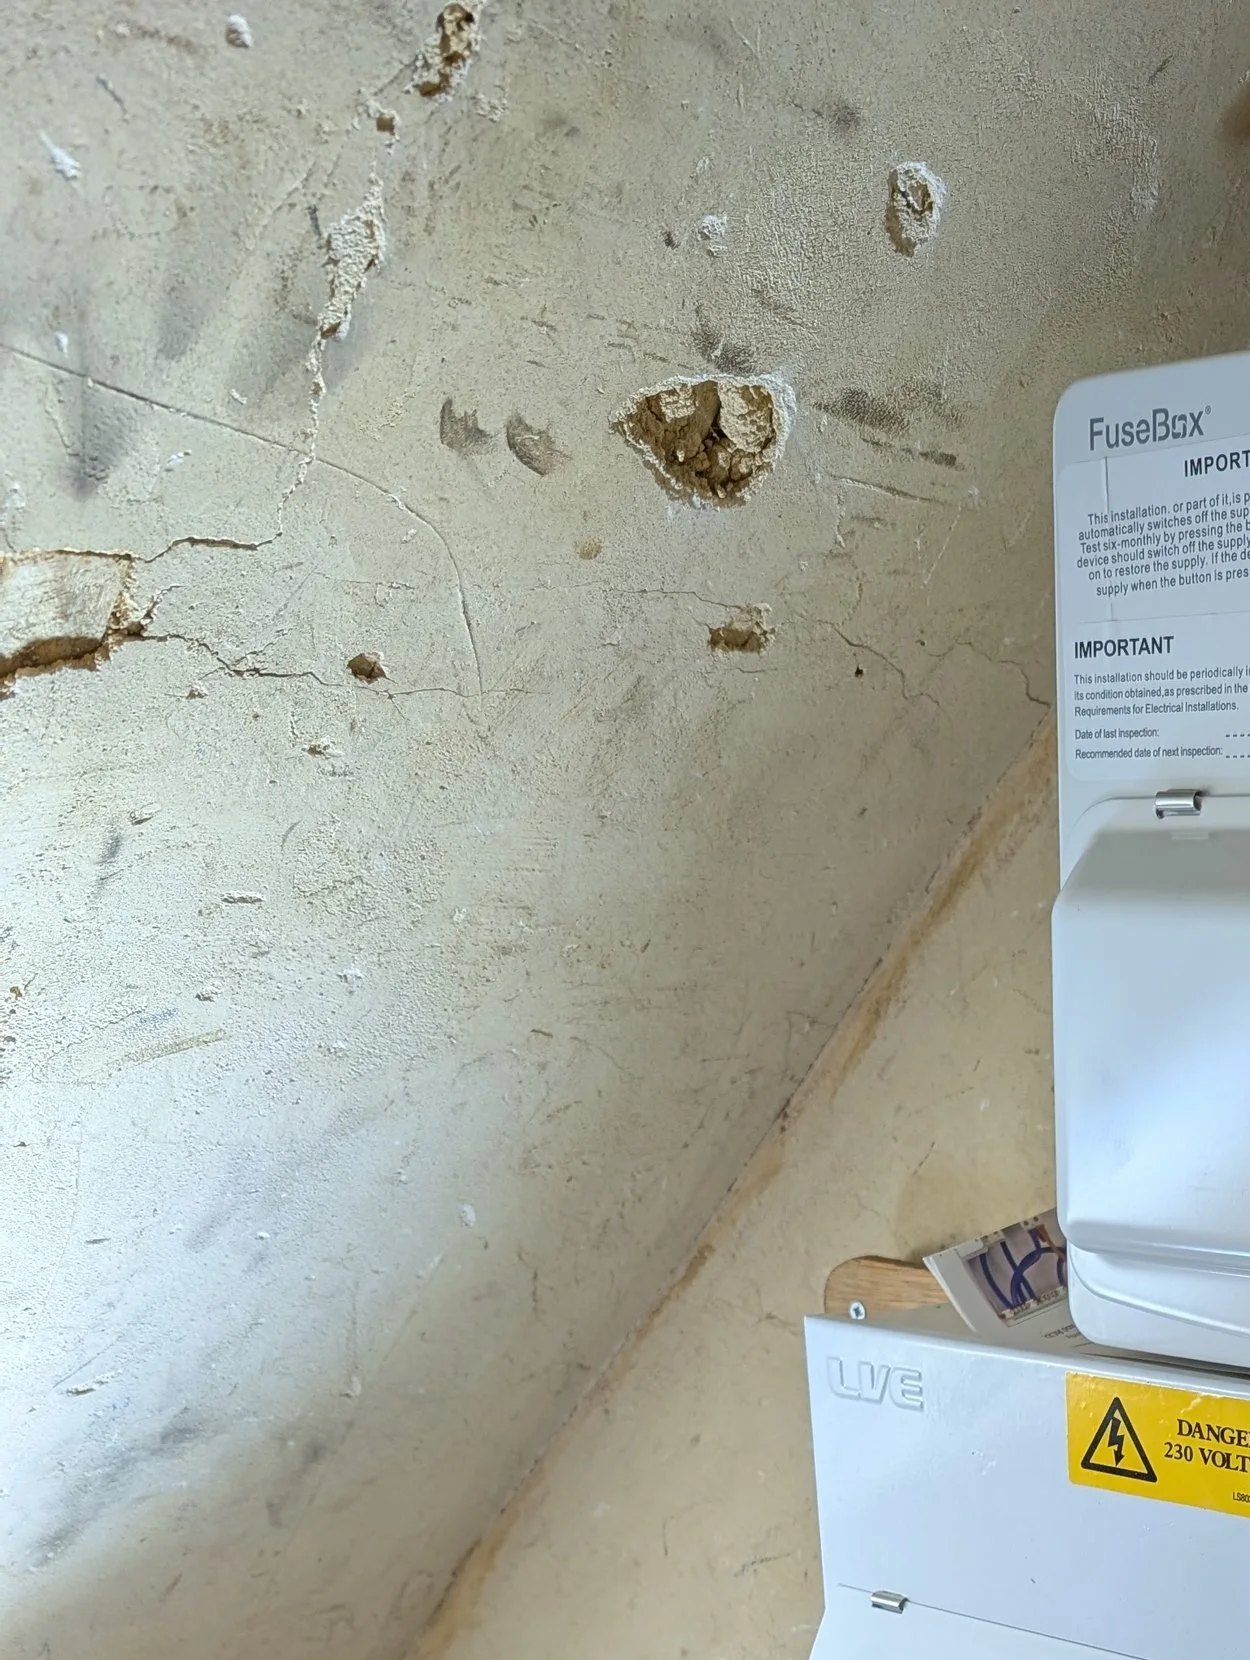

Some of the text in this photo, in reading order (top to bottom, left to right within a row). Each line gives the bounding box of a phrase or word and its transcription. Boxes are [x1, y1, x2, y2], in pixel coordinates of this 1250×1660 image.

[1088, 511, 1108, 525] This
[1172, 502, 1183, 512] or
[1186, 496, 1206, 514] part
[1209, 494, 1219, 507] of
[1078, 520, 1145, 541] automatically
[1146, 514, 1192, 531] switches
[1194, 510, 1208, 524] off
[1210, 508, 1227, 521] the
[1096, 580, 1128, 597] supply
[1130, 577, 1158, 591] when
[1159, 574, 1176, 587] the
[1178, 570, 1212, 585] button
[1213, 568, 1223, 581] is
[1074, 636, 1174, 659] IMPORTANT
[1074, 673, 1092, 685] This
[1094, 671, 1142, 684] installation
[1144, 669, 1174, 681] should
[1176, 668, 1188, 679] be
[1189, 665, 1243, 681] periodically
[1074, 690, 1084, 701] its
[1085, 688, 1123, 700] condition
[1176, 683, 1222, 698] prescribed
[1224, 683, 1232, 693] in
[1233, 682, 1248, 693] the
[1074, 700, 1239, 719] Requirements for Electrical Installations.
[1075, 726, 1159, 740] Date of last inspection:
[1075, 744, 1223, 759] Recommended date of next inspection:
[1164, 1441, 1194, 1463] 230
